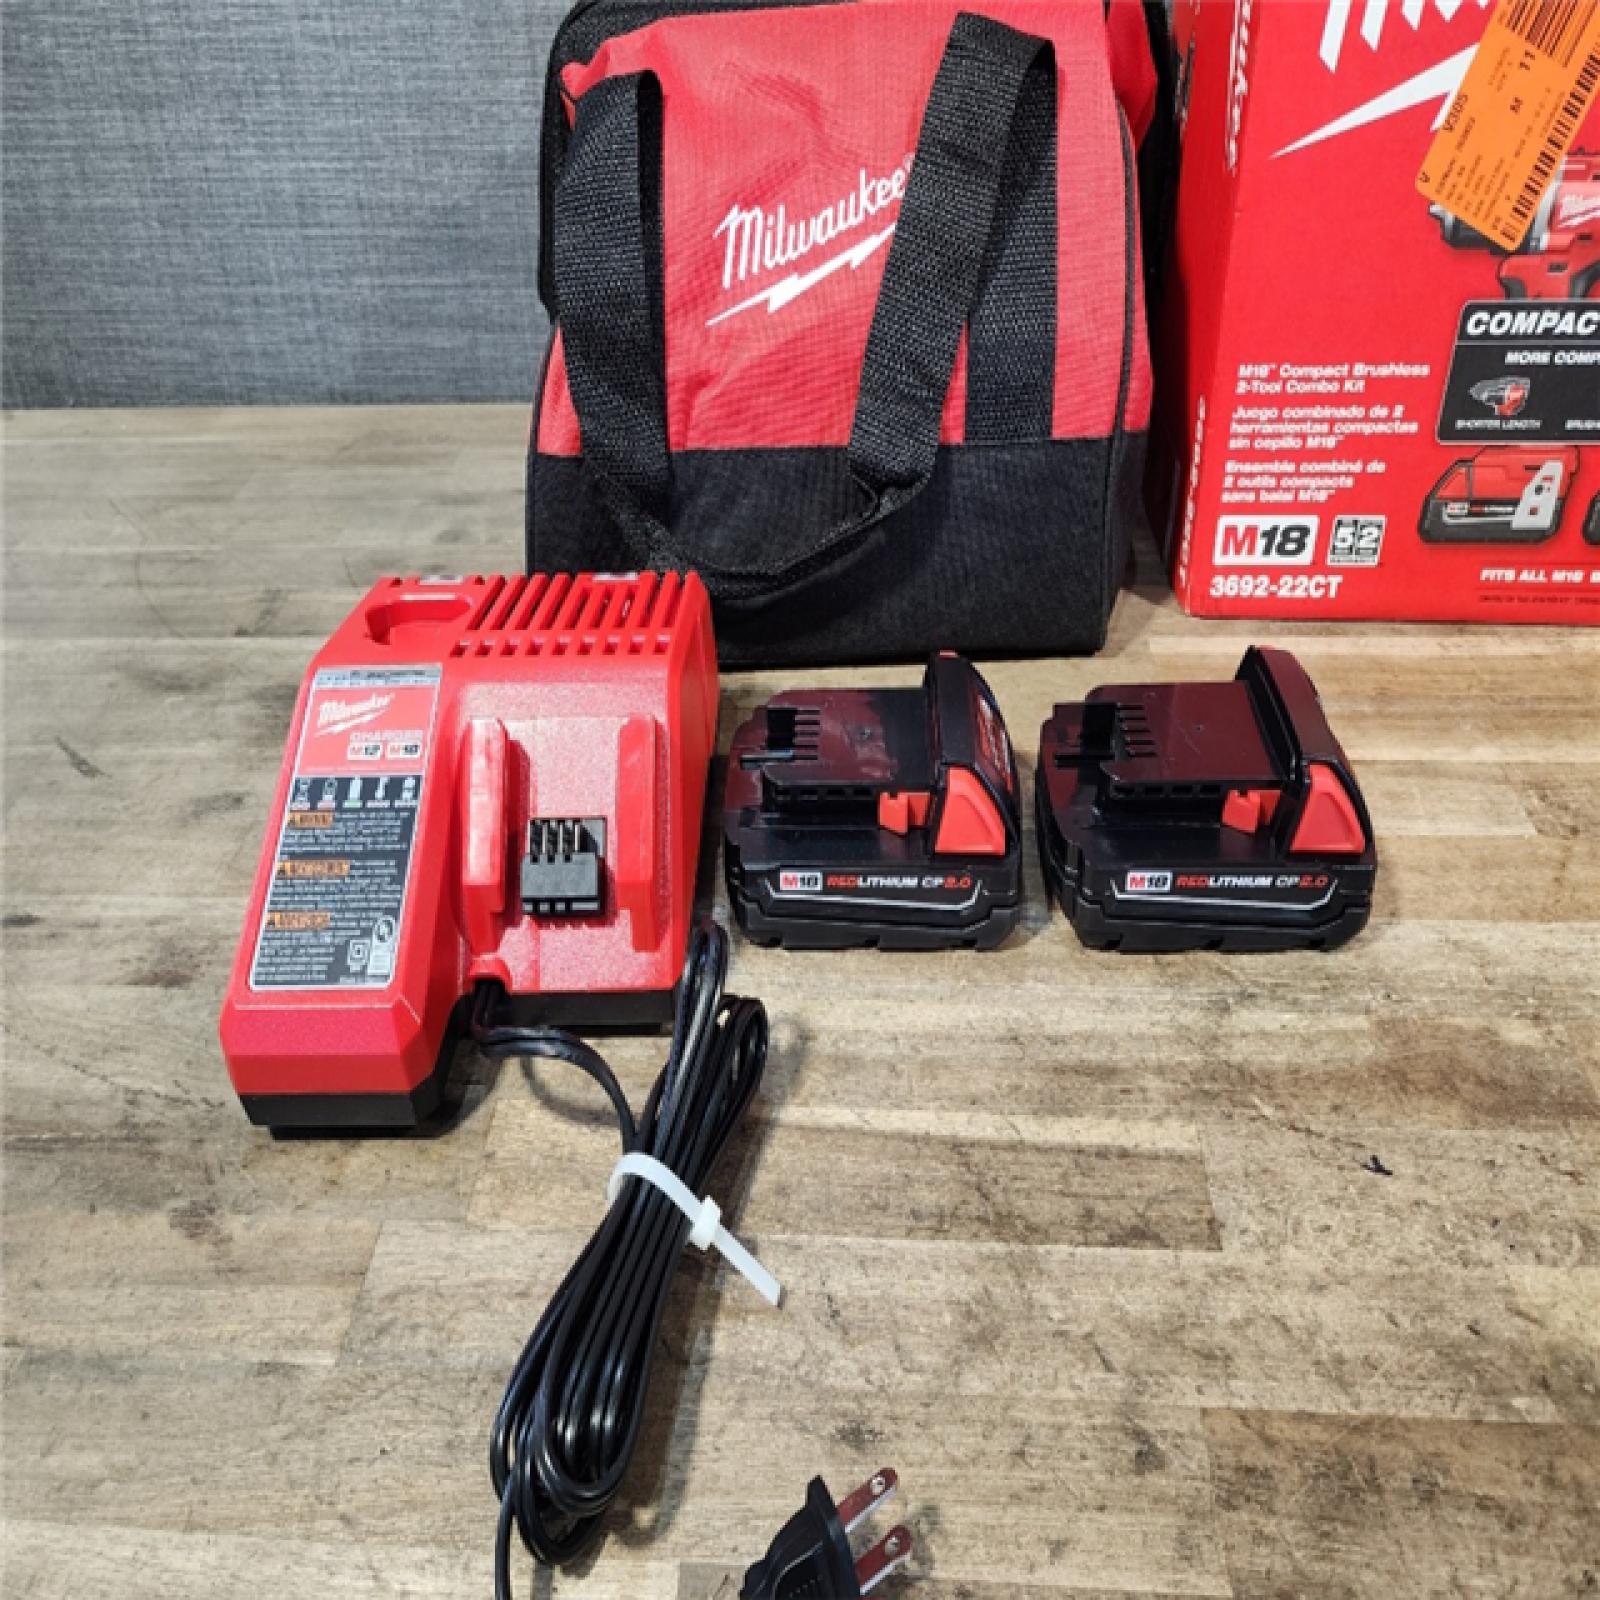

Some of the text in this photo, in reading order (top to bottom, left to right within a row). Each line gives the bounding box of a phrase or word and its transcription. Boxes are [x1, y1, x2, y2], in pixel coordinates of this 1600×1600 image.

[712, 163, 906, 291] Milwaukee
[1504, 351, 1552, 366] MORE
[1279, 363, 1349, 380] Compact
[1352, 361, 1430, 378] Brushless
[1236, 379, 1365, 394] 2-Tool Combo Kit
[1232, 405, 1278, 421] Juego
[1282, 405, 1366, 419] combinado
[1369, 404, 1389, 419] de
[1229, 436, 1251, 449] sin
[1366, 459, 1387, 474] de
[1219, 524, 1311, 557] M18
[1480, 568, 1516, 582] FITS
[1517, 568, 1549, 583] ALL
[1209, 574, 1344, 598] 3692-22CT
[782, 873, 820, 889] M18
[827, 873, 918, 889] REDLITHIUM
[1128, 873, 1170, 890] M18
[1176, 873, 1273, 889] REDLITHIUM
